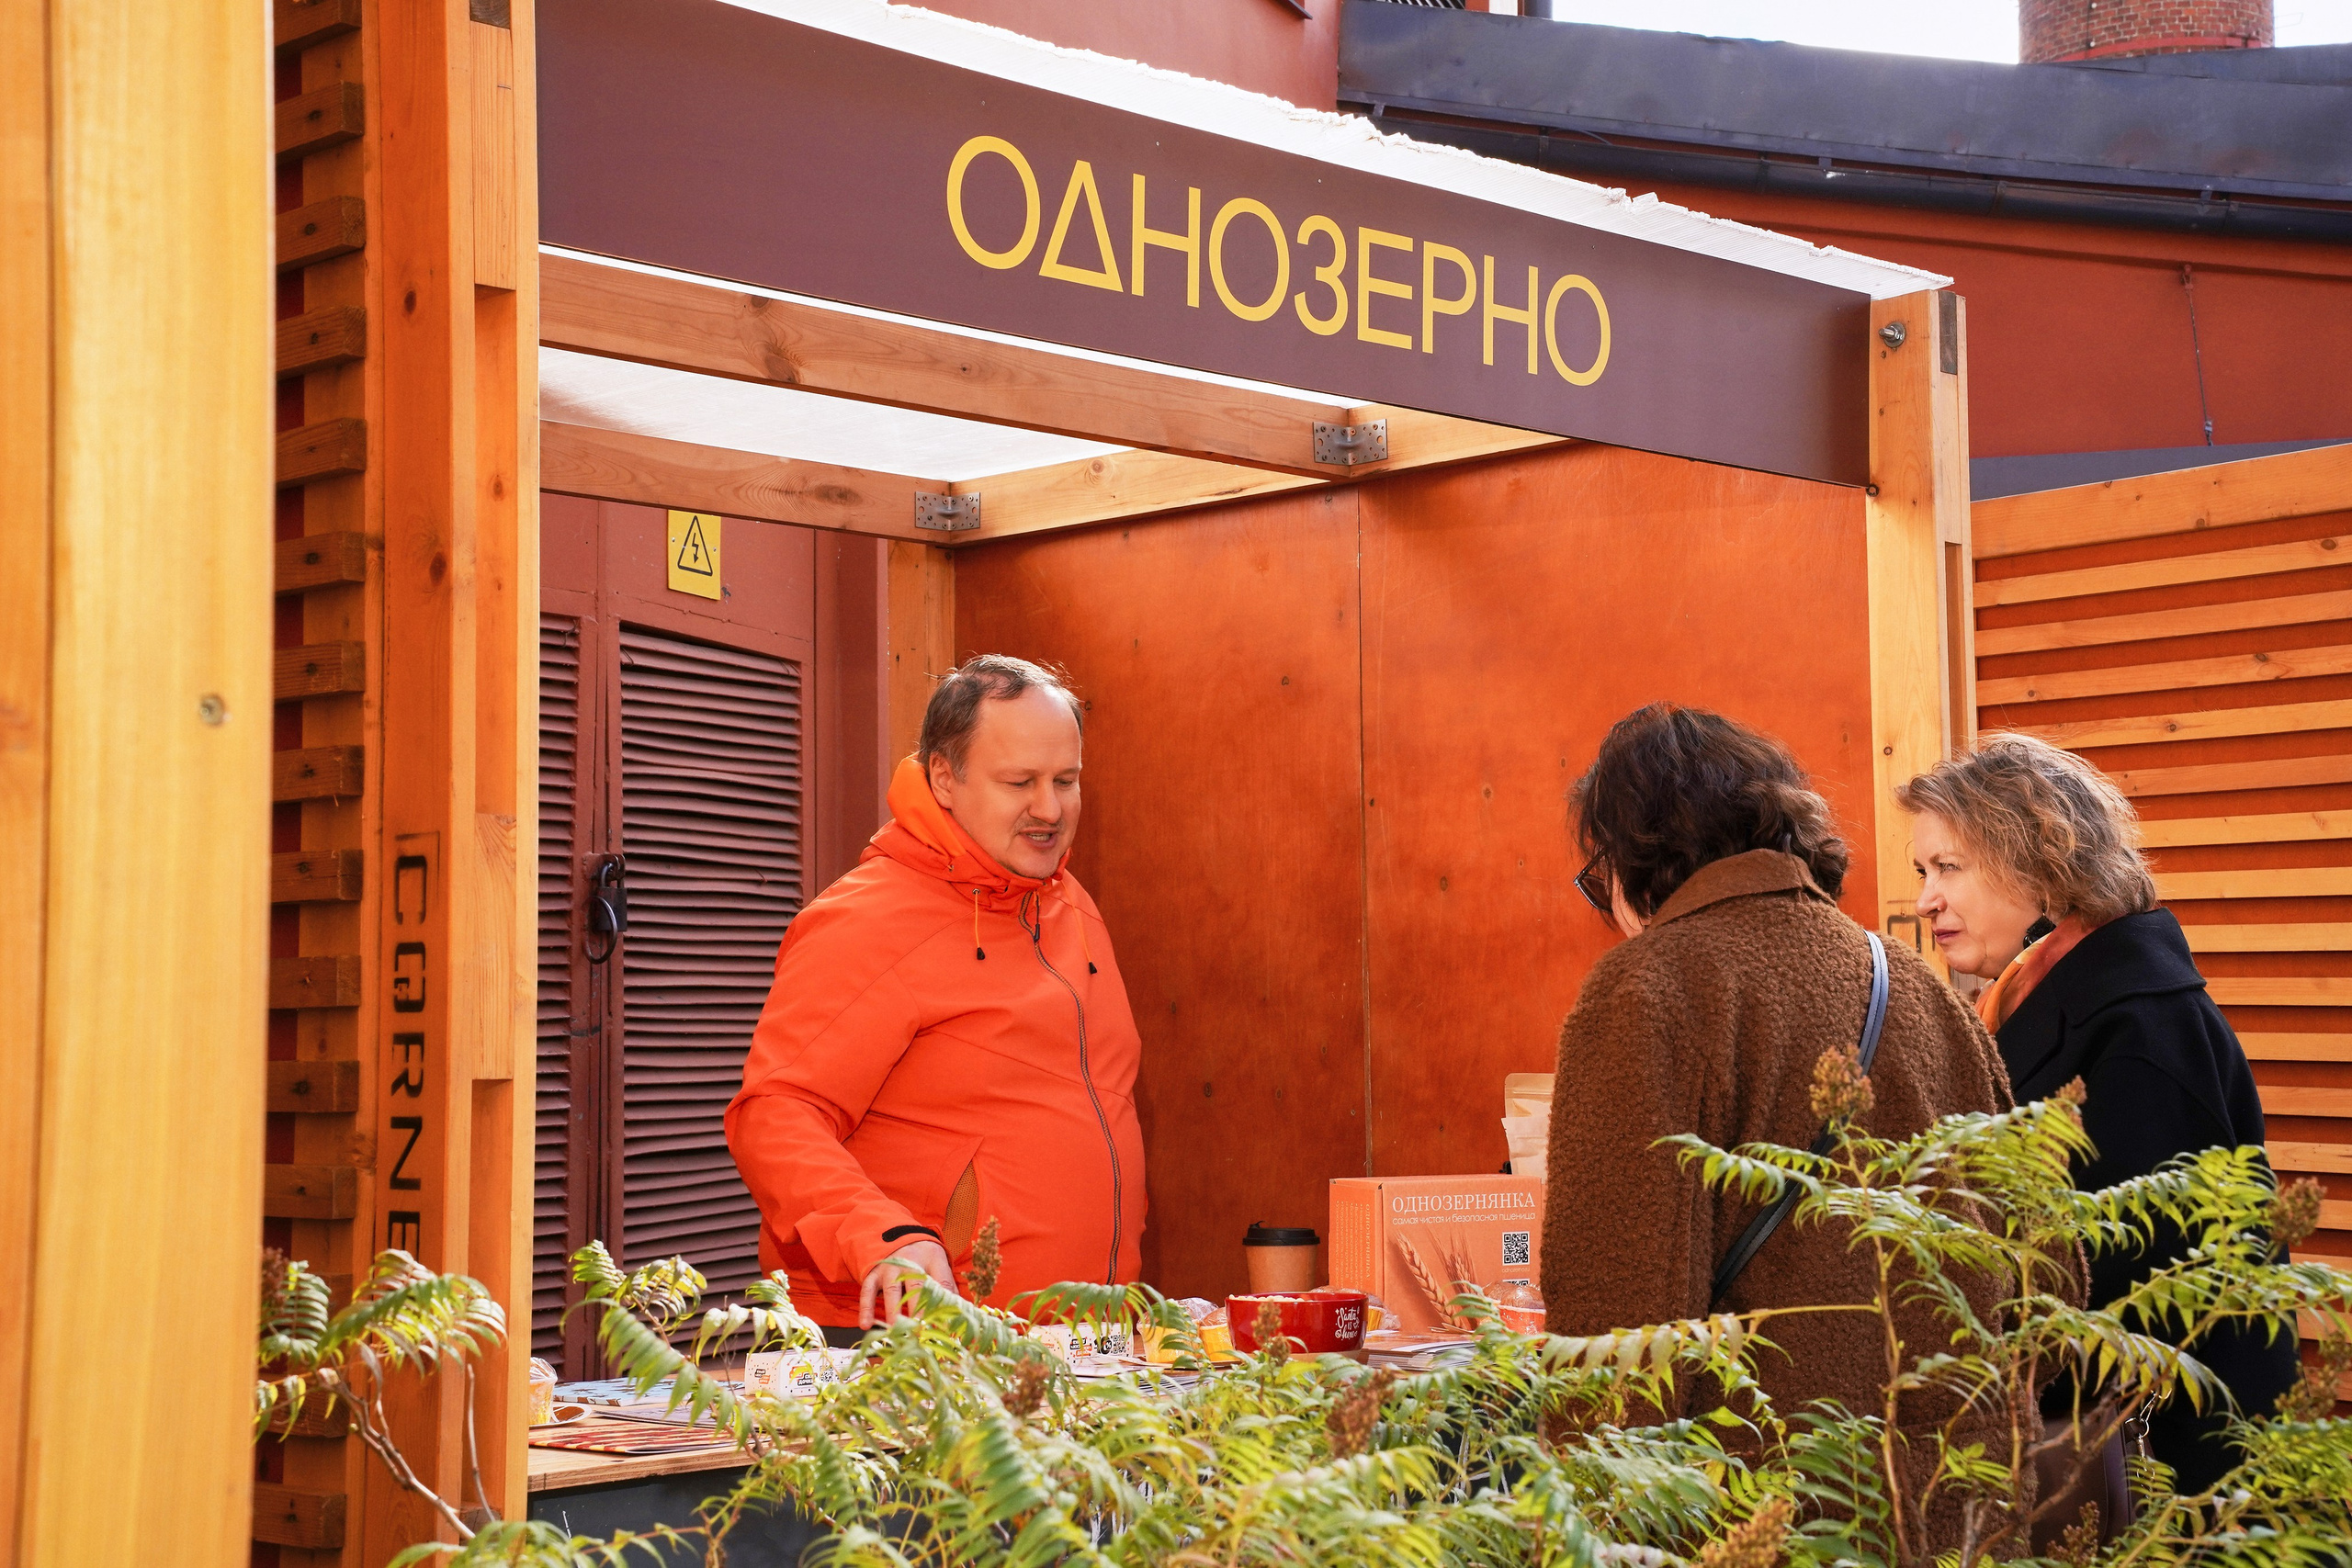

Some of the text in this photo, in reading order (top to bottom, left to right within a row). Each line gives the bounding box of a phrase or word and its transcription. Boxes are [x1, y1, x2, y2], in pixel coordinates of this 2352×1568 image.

[946, 135, 1611, 386] ОДНОЗЕРНО
[388, 855, 427, 1263] CORNE
[1392, 1192, 1535, 1214] ОДНОЗЕРНЯНКА
[1393, 1217, 1419, 1225] самая
[1419, 1215, 1444, 1224] чистая
[1452, 1213, 1498, 1223] безопасная
[1498, 1213, 1535, 1221] пшеница
